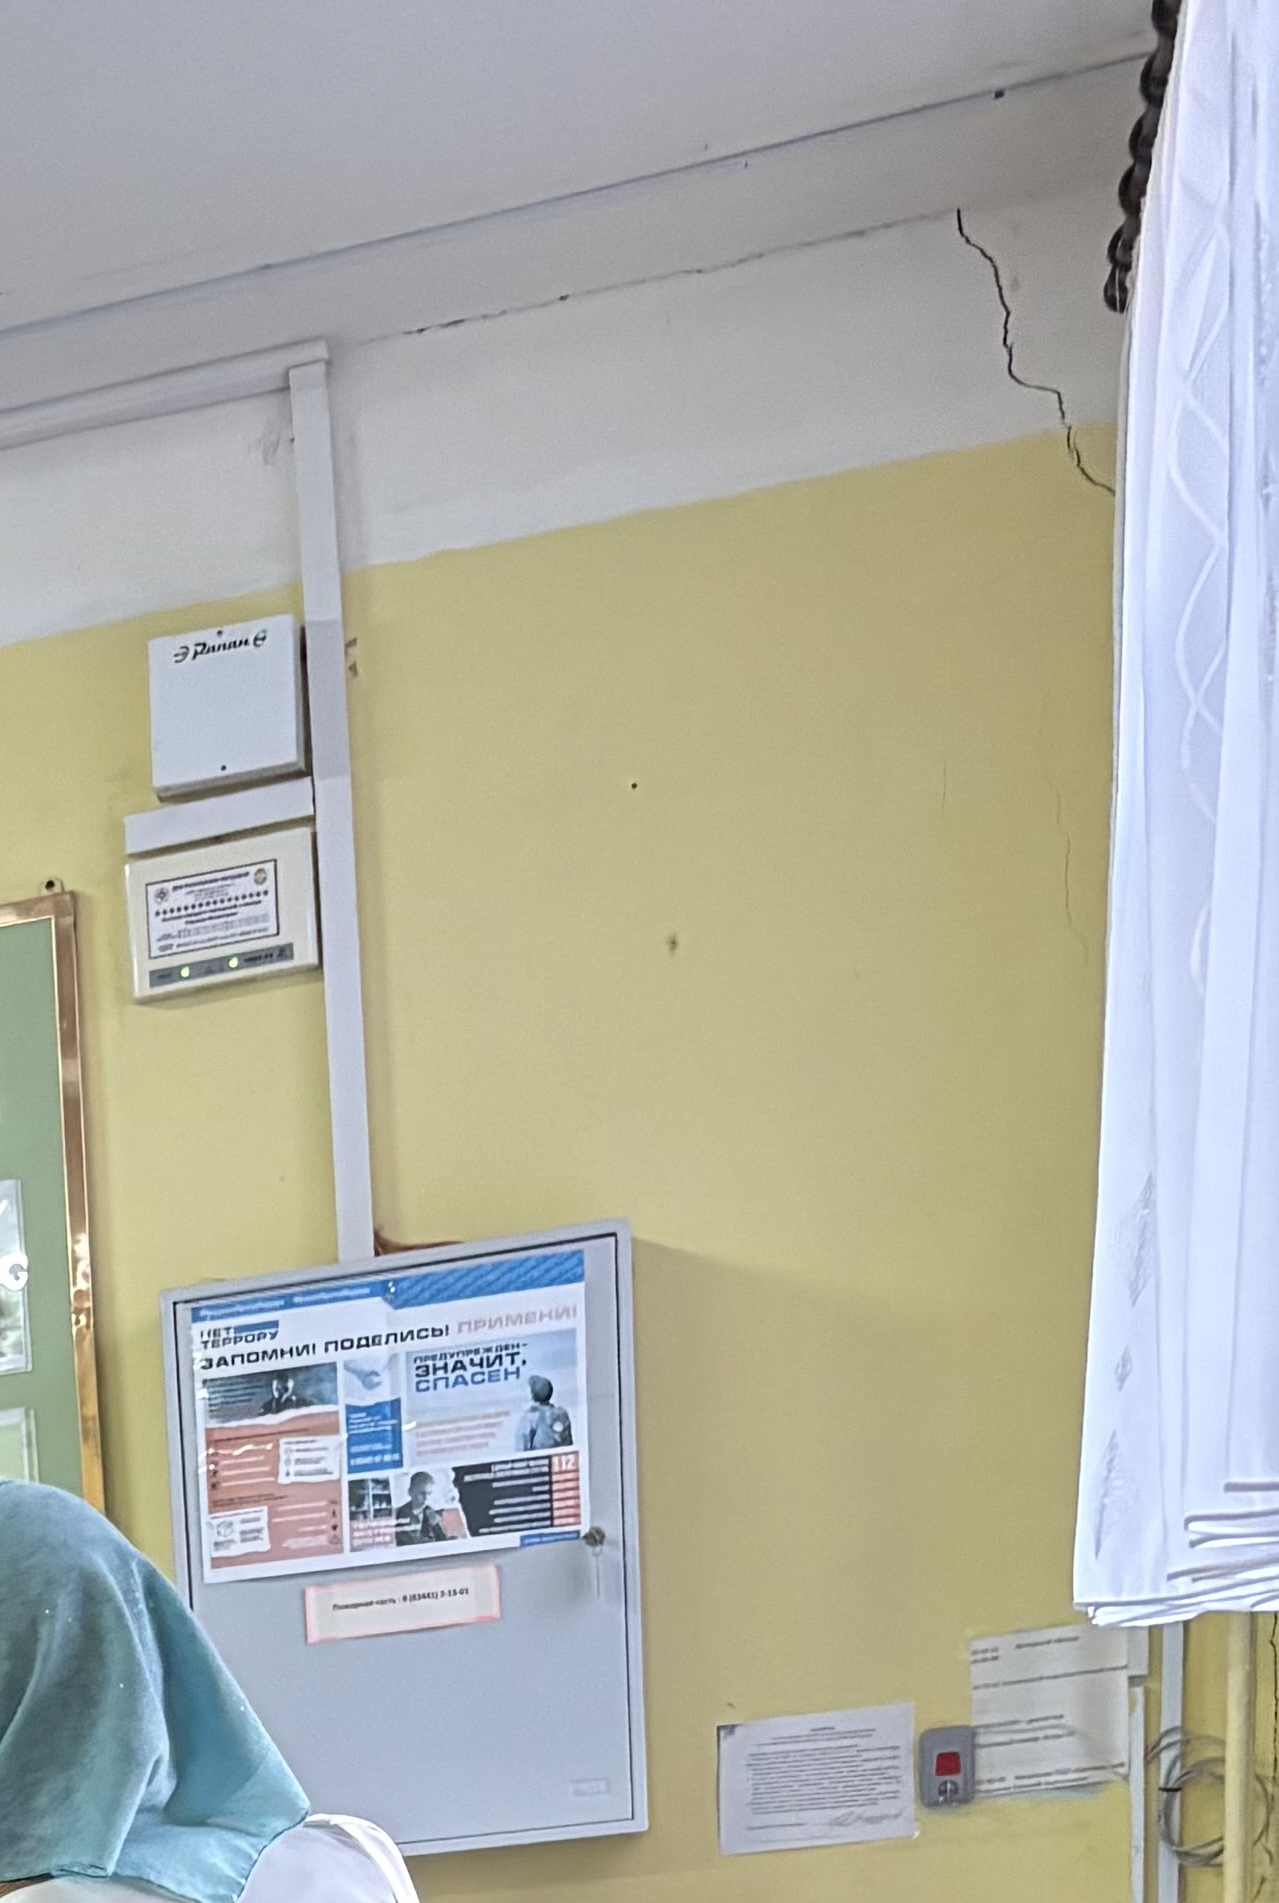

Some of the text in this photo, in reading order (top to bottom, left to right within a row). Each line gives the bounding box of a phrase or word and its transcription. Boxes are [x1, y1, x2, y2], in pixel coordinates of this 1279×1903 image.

[200, 1304, 577, 1370] ЗАПОМНИ! ПОДЕЛИСЬ! ПРИМЕНИ!
[200, 1331, 279, 1350] ТЕРРОРУ
[415, 1366, 521, 1393] СПАСЕН
